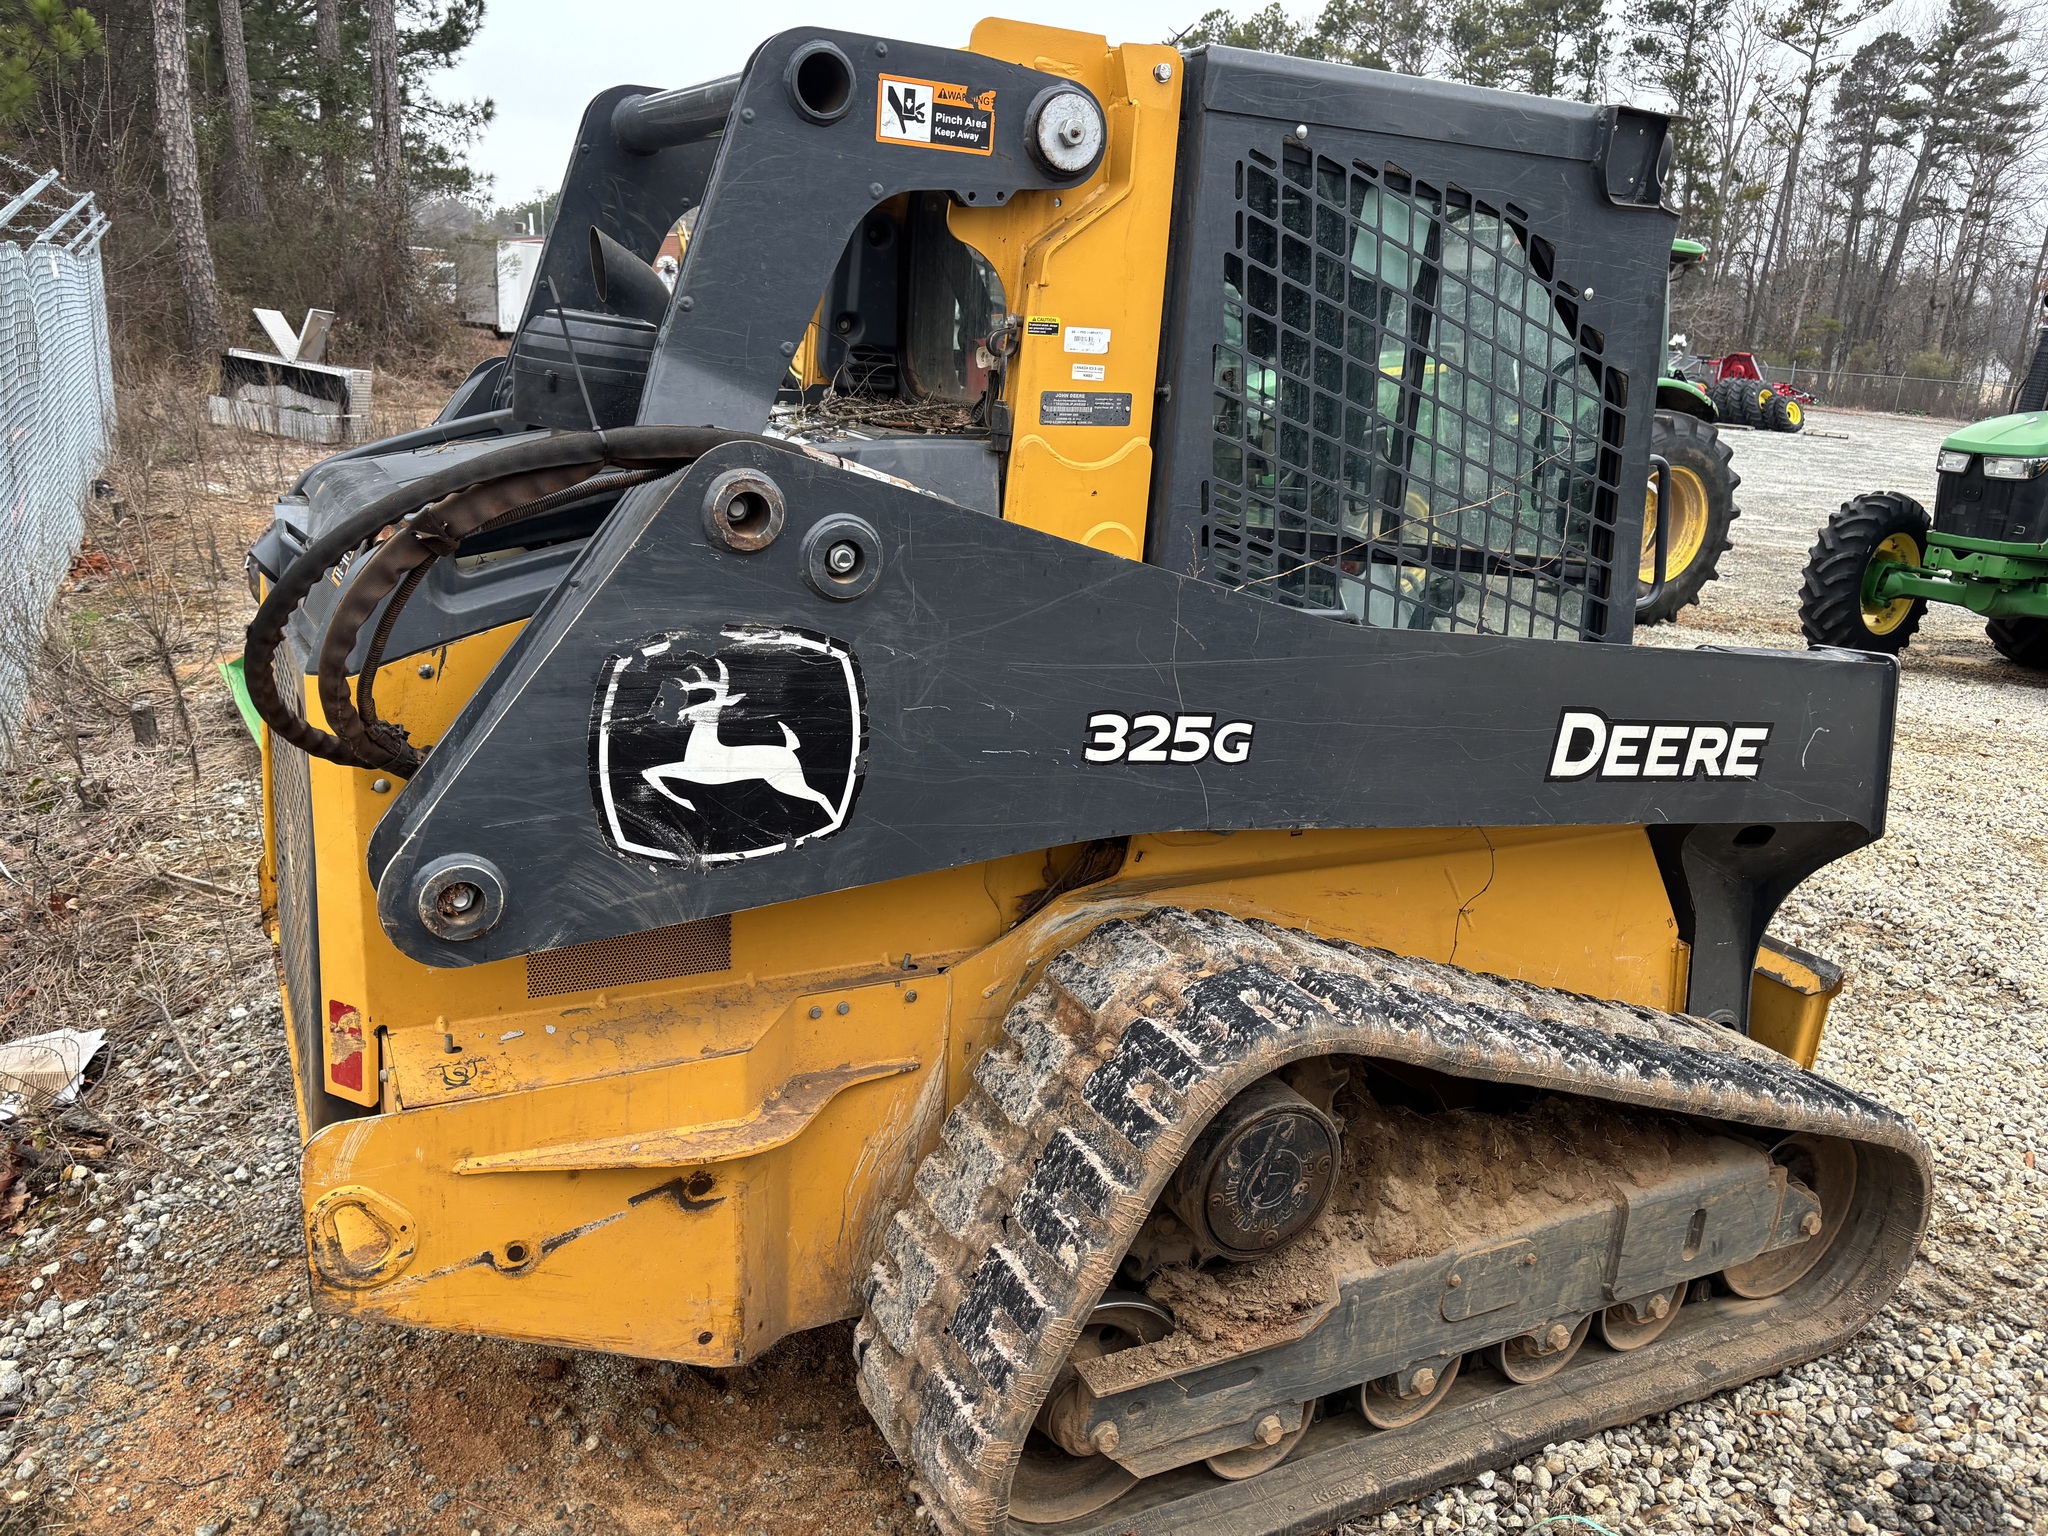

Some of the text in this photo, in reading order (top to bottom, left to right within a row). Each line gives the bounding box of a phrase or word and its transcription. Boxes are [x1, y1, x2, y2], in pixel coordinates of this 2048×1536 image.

[947, 91, 990, 105] WARING
[936, 112, 987, 129] Pinch Area
[935, 127, 980, 143] Keep Away
[1084, 713, 1254, 763] 325G
[1549, 712, 1769, 777] DEERE
